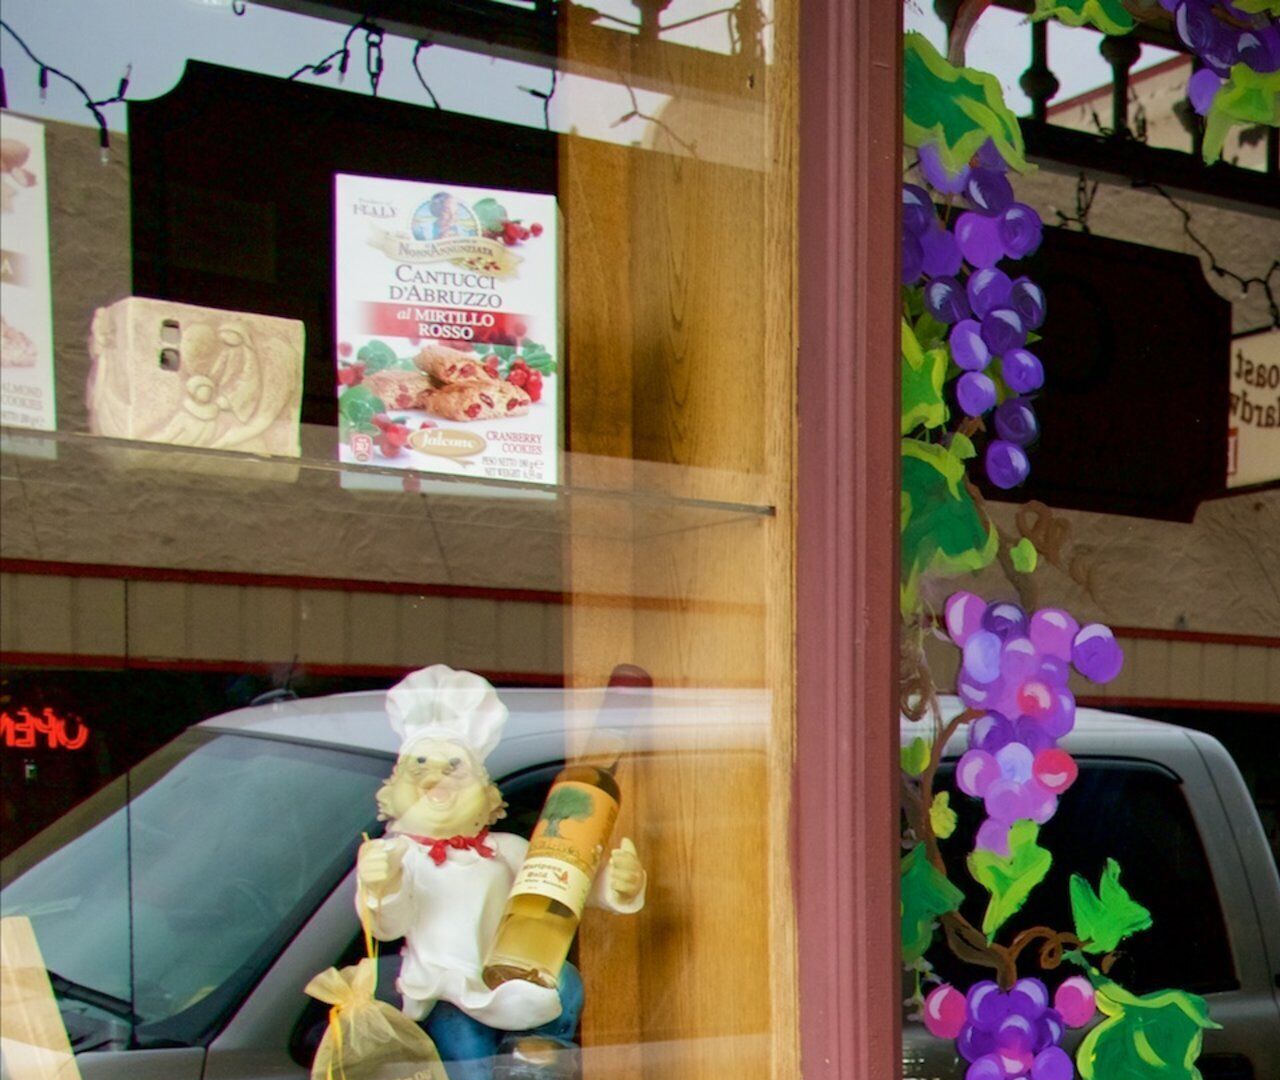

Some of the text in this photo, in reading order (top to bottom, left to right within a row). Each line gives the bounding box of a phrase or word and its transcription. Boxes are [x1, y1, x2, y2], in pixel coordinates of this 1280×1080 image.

[395, 264, 495, 290] CANTUCCI
[389, 285, 503, 309] D'ABRUZZO
[397, 308, 495, 327] al MIRTILLO
[419, 323, 474, 339] ROSSO
[486, 431, 544, 445] CRANBERRY
[502, 444, 543, 455] COOKIES
